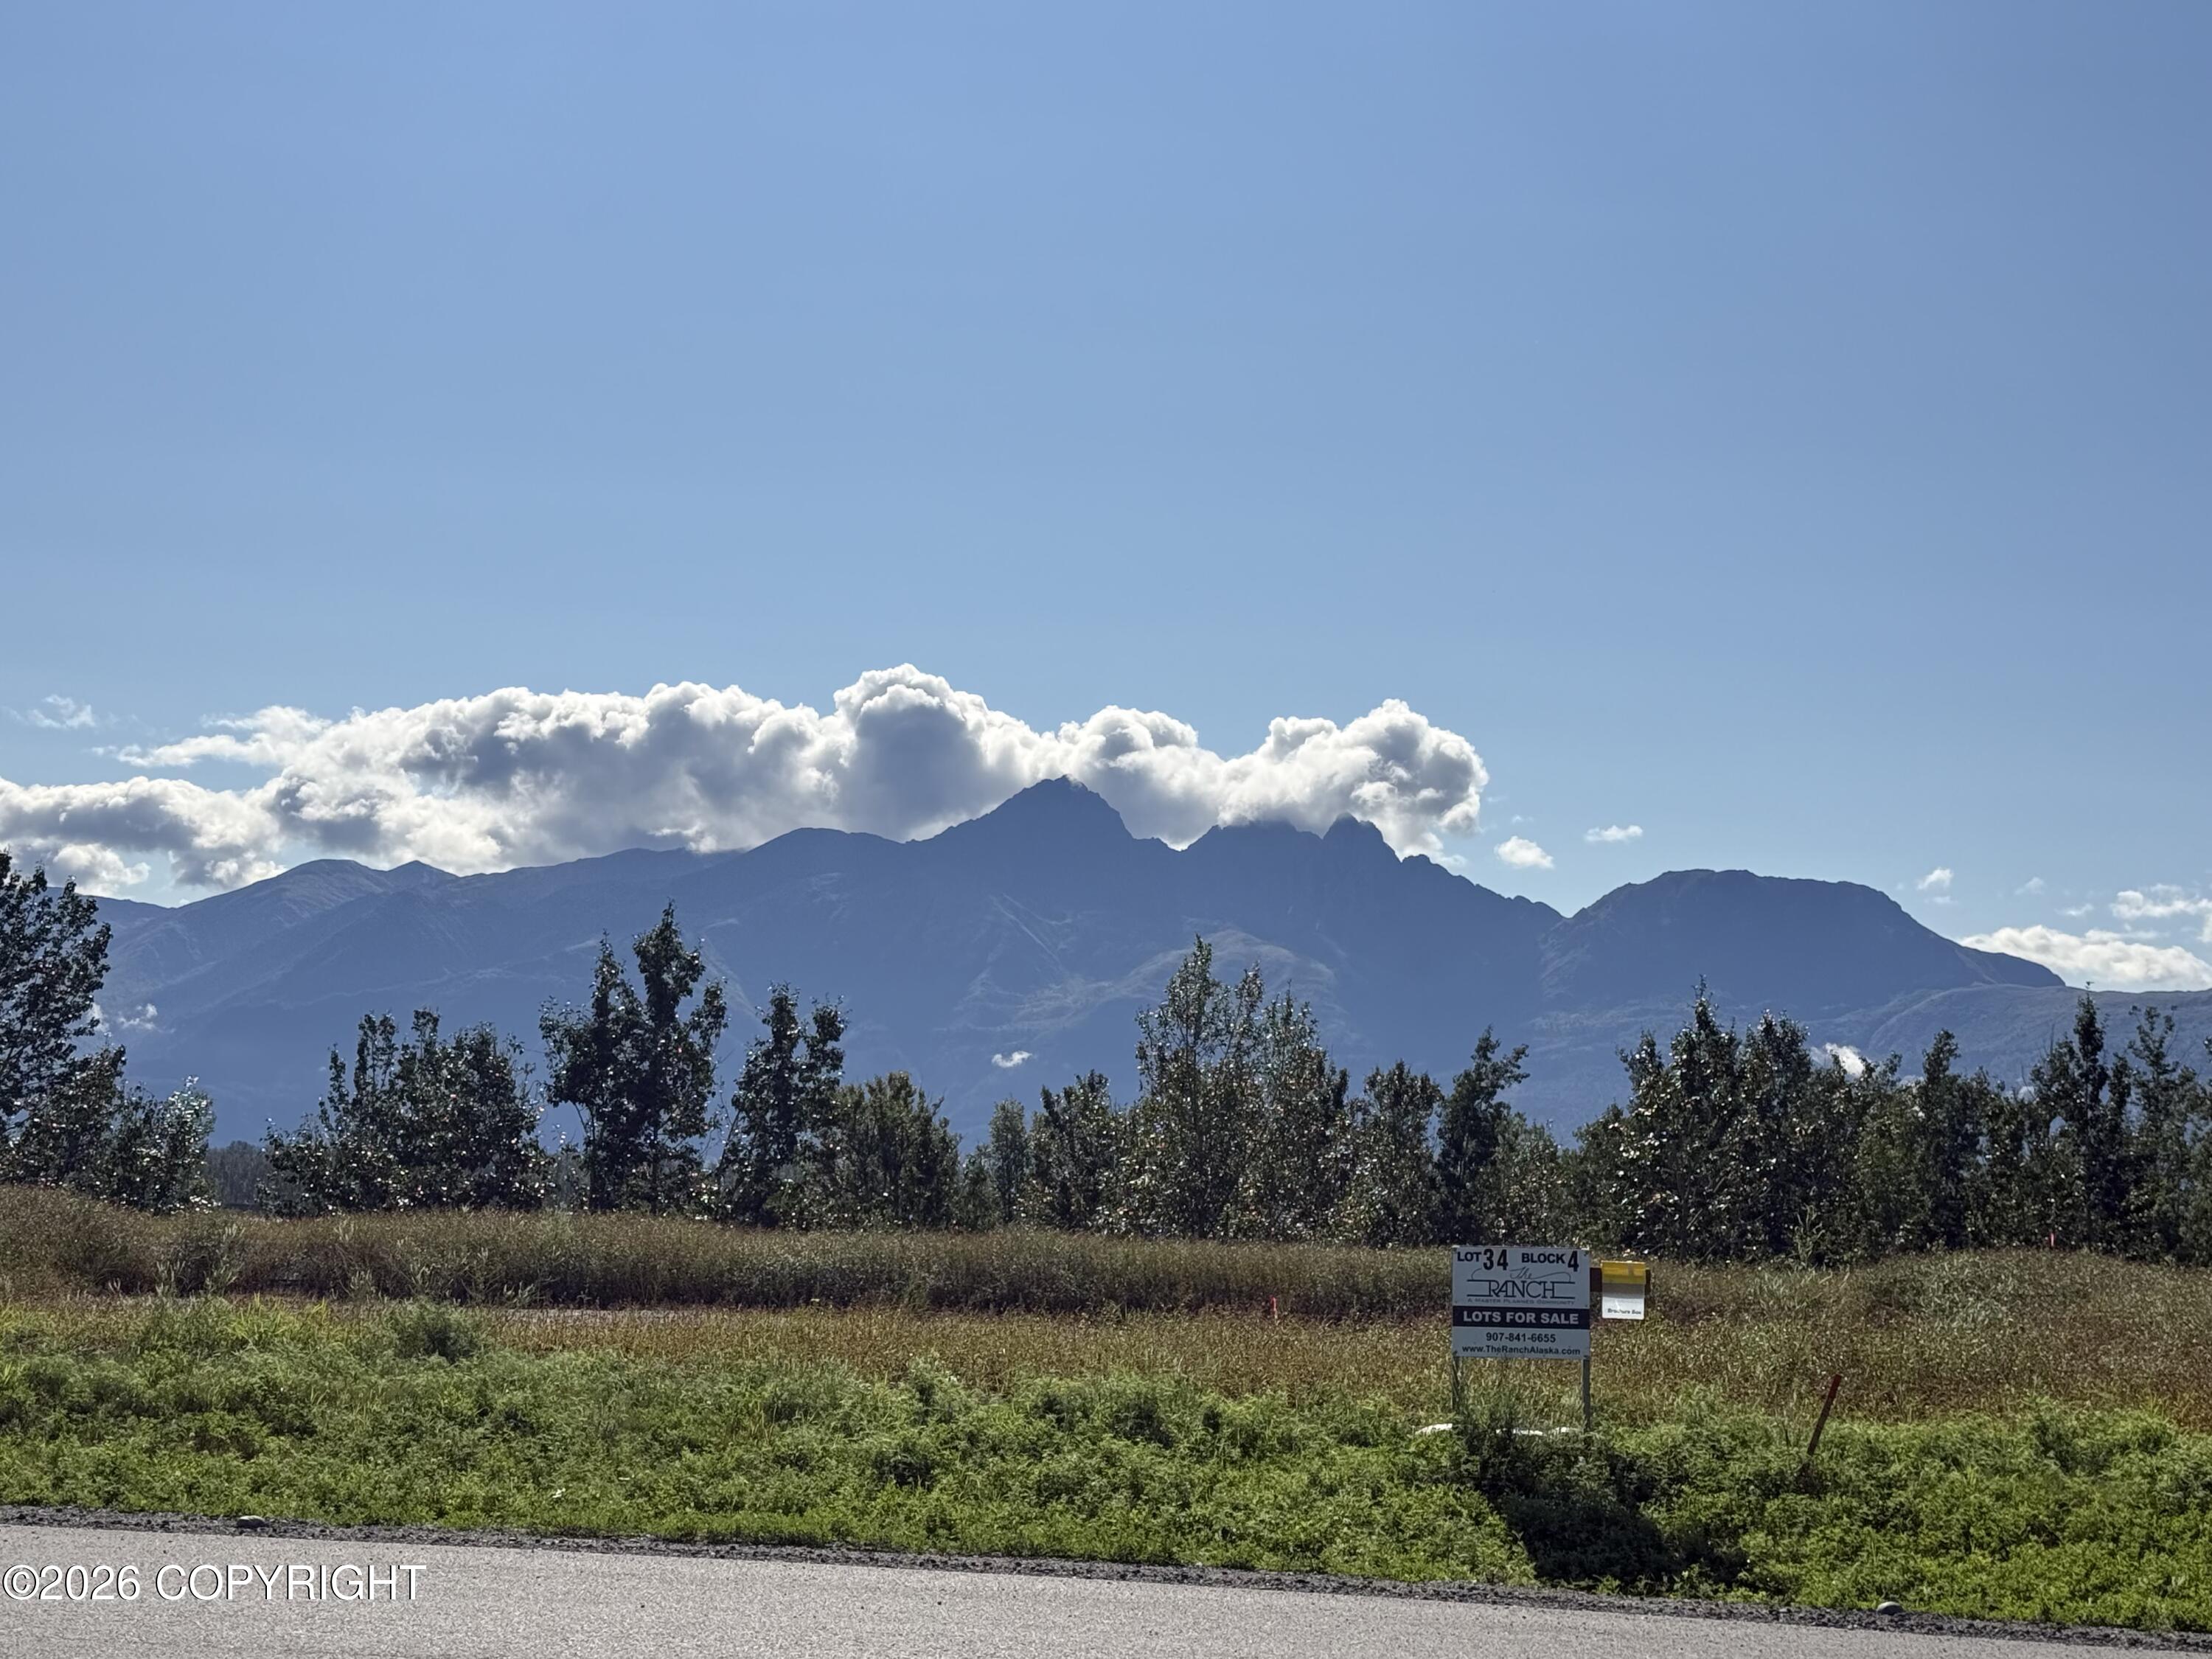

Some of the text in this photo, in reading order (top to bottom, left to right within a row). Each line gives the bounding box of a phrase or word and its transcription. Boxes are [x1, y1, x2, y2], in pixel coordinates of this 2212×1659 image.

[1457, 1248, 1579, 1272] LOT 34 BLOCK 4
[1509, 1266, 1533, 1279] The
[1489, 1279, 1556, 1298] RANCH
[1463, 1311, 1579, 1324] LOTS FOR SALE
[1486, 1332, 1557, 1343] 907-841-6655
[1462, 1345, 1581, 1355] www.TheRanchAlaska.com
